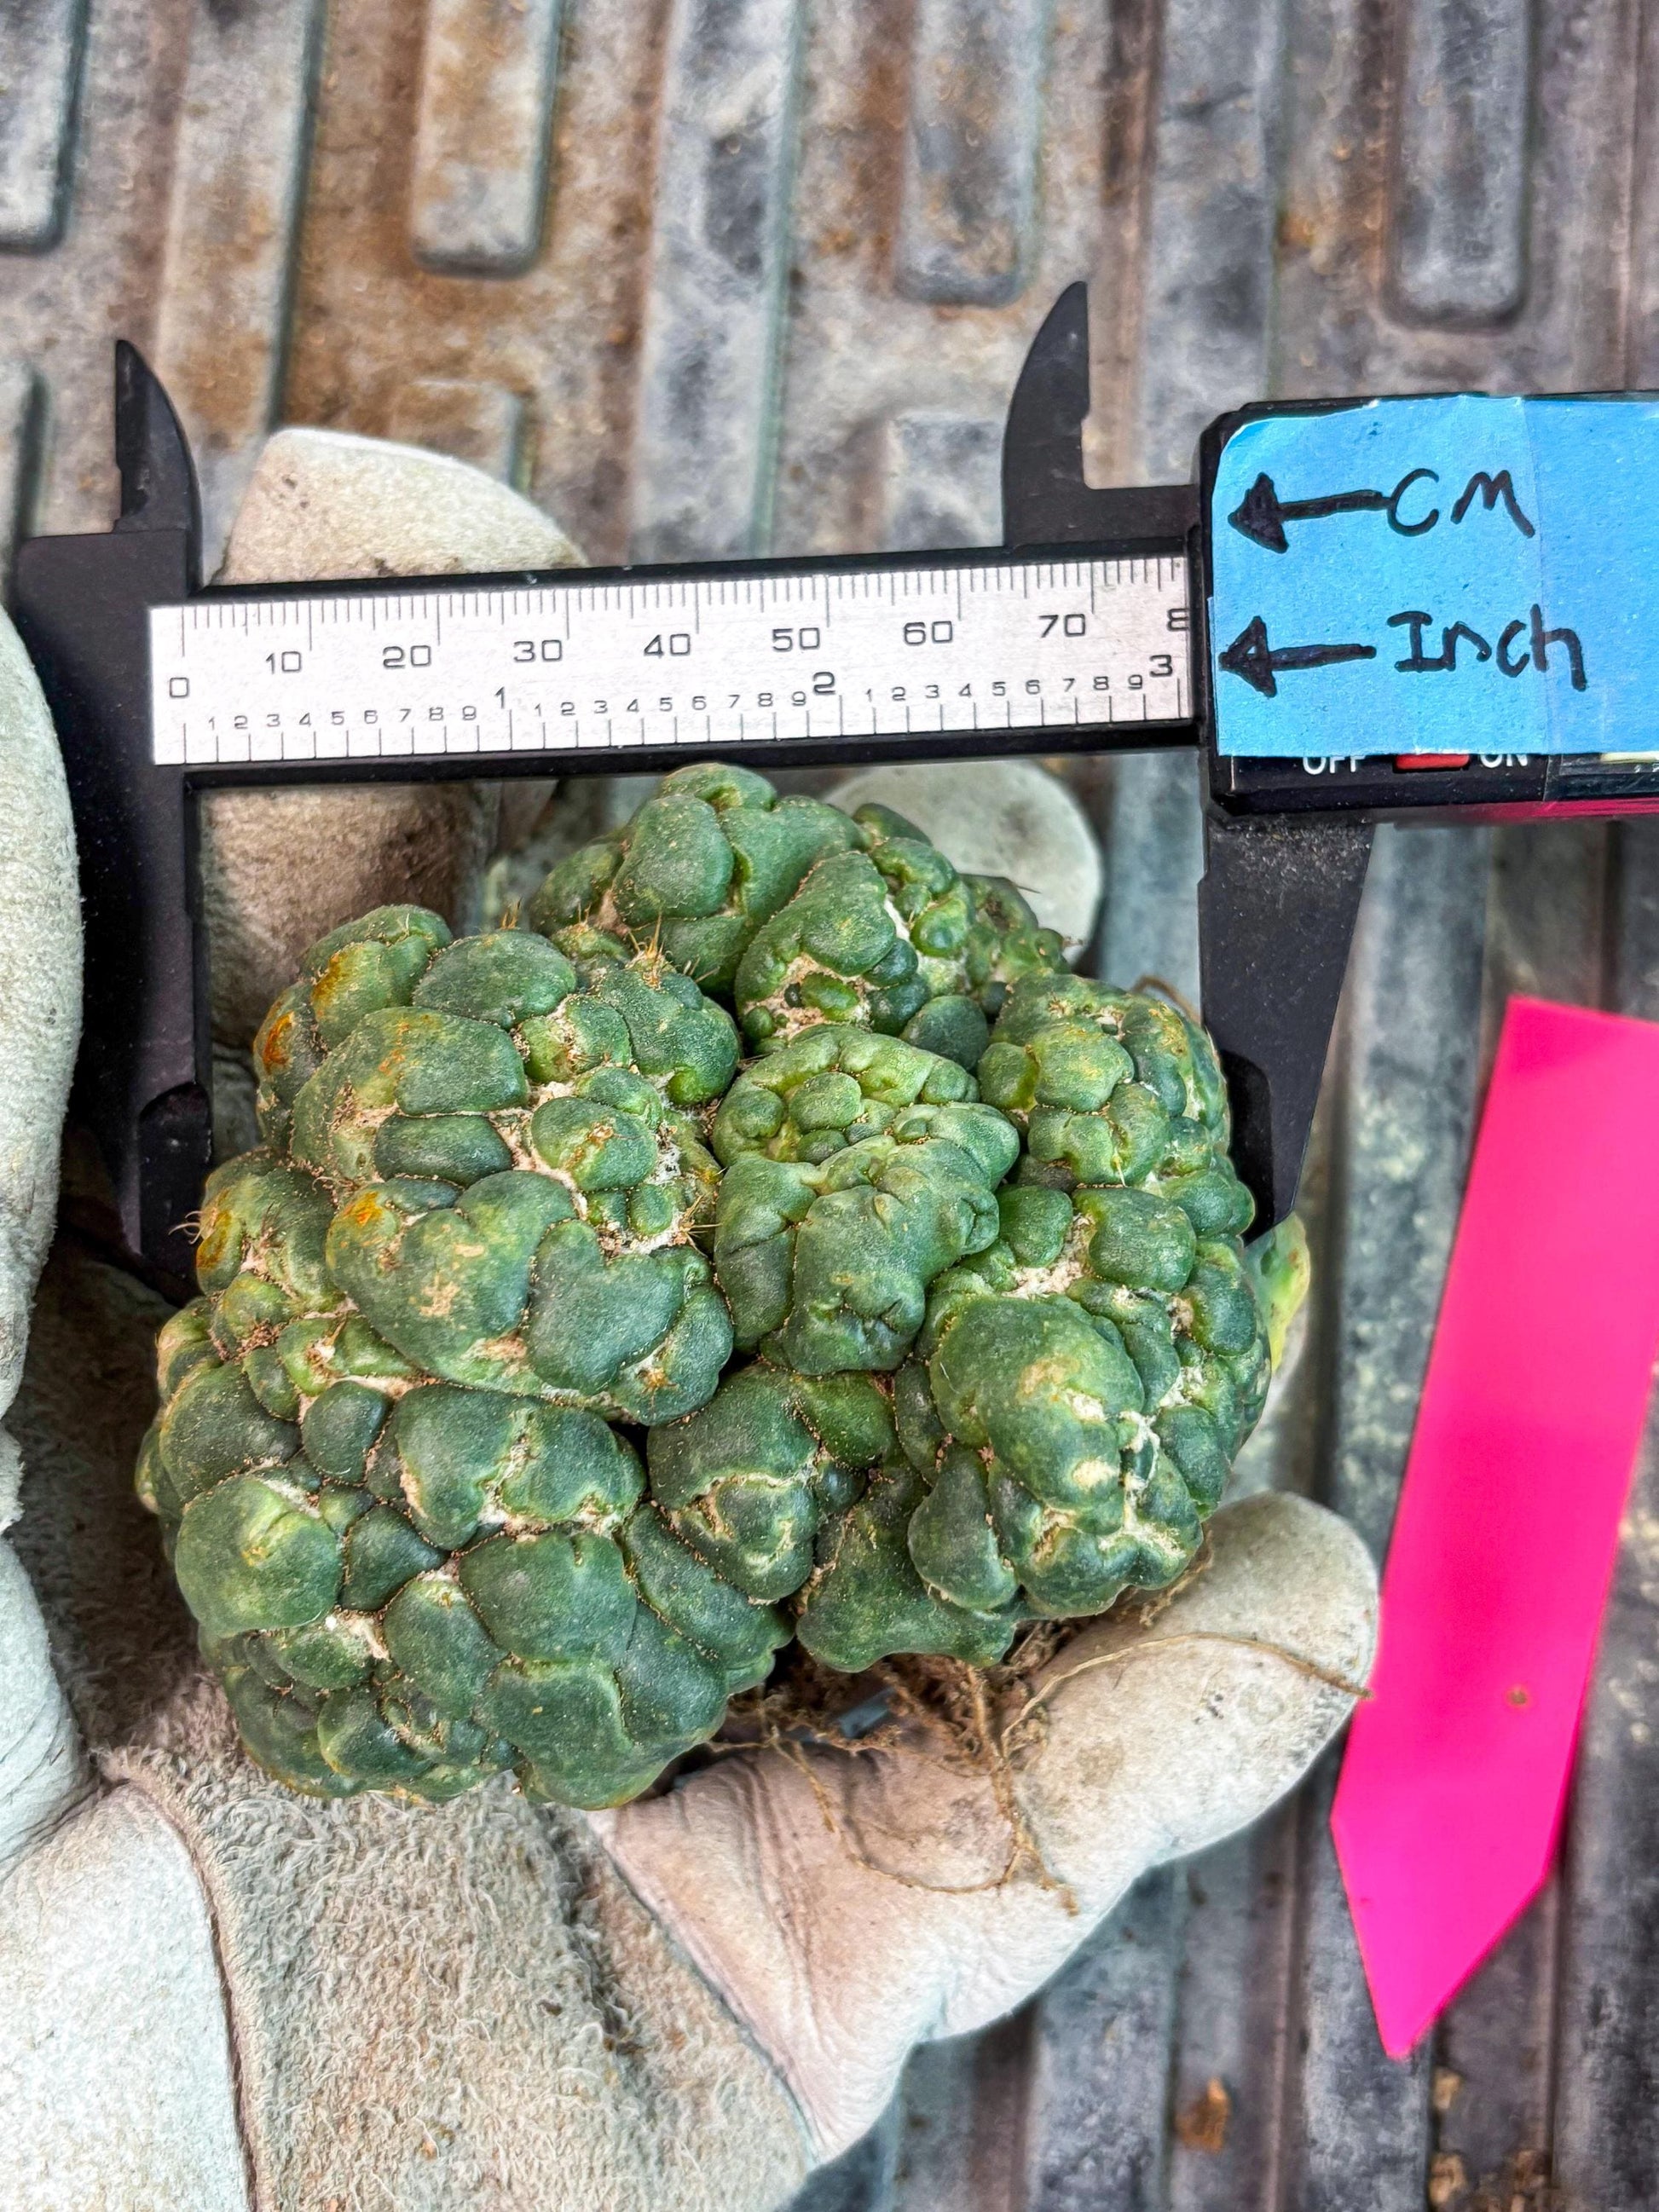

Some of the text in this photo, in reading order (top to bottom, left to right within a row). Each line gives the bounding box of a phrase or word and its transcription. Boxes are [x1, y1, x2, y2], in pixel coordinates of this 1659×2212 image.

[169, 677, 191, 699] 0
[265, 651, 303, 674] 10
[383, 645, 432, 669] 20
[513, 639, 564, 663] 30
[644, 633, 692, 658] 40
[772, 627, 821, 652] 50
[903, 621, 954, 646] 60
[1038, 614, 1087, 638] 70
[1386, 603, 1588, 692] Inch
[208, 655, 1174, 731] 1 2 3 4 5 6 7 8 9 1 1 2 3 4 5 6 7 8 9 2 1 2 3 4 5 6 7 8 9 3
